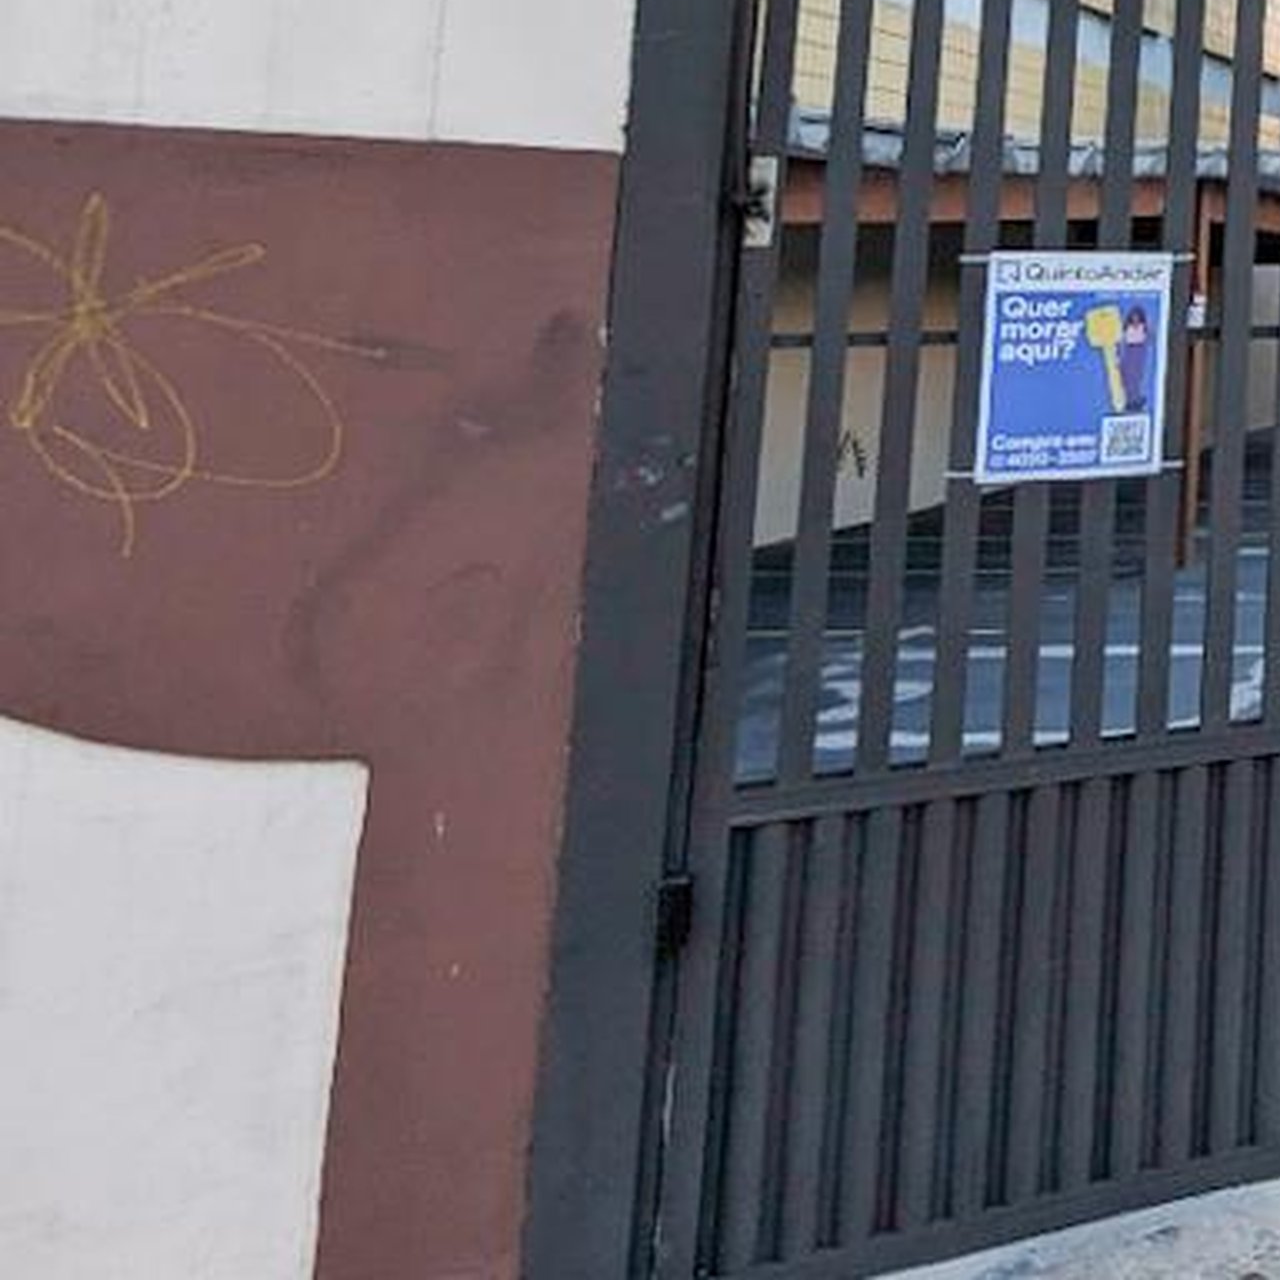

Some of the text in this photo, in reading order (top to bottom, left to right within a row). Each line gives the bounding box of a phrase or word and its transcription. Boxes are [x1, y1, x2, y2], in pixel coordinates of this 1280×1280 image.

[1002, 296, 1072, 318] Quer
[1000, 321, 1084, 340] morar
[1000, 339, 1077, 365] aqui?
